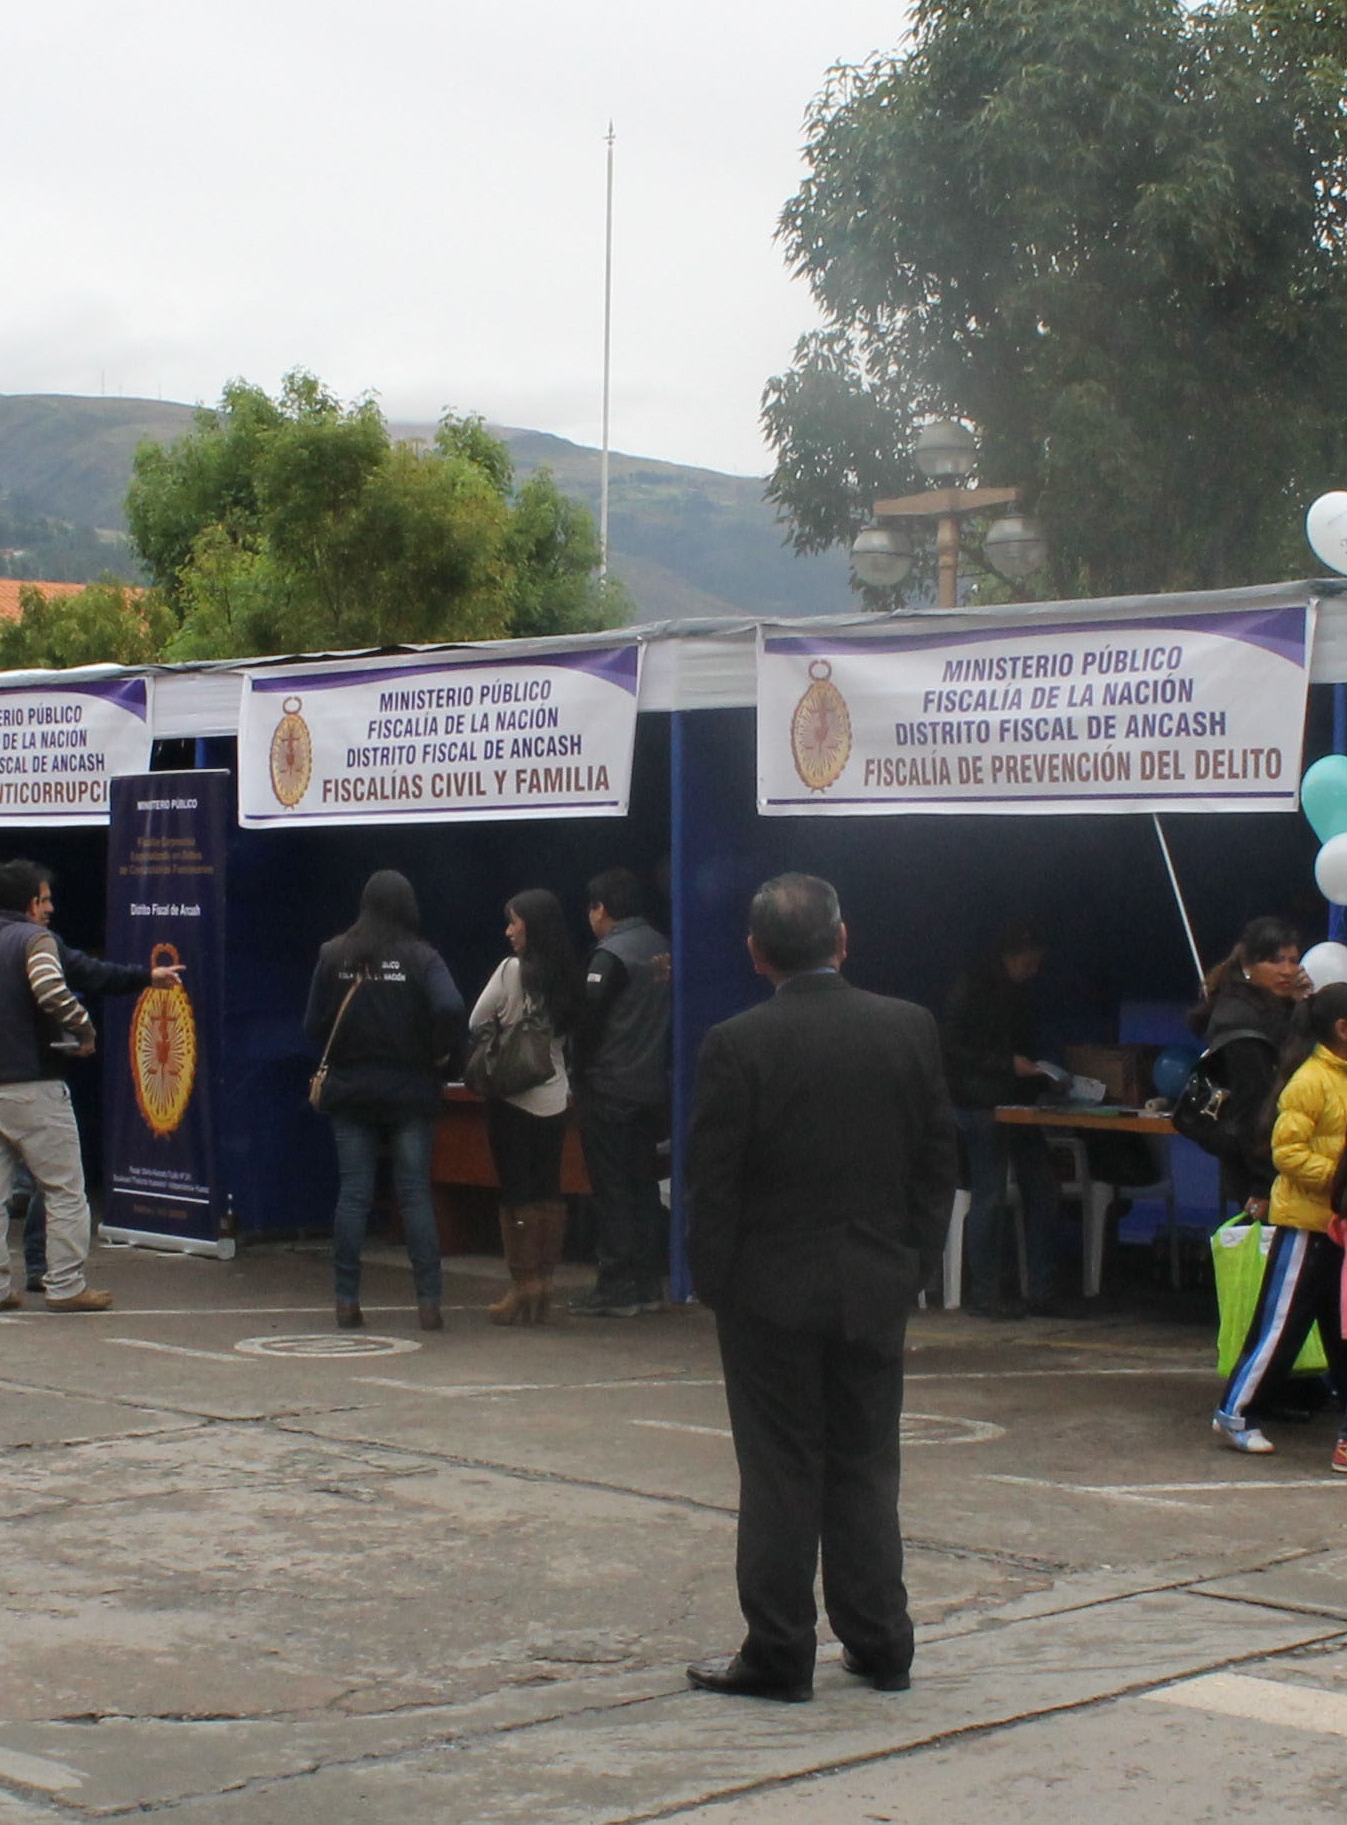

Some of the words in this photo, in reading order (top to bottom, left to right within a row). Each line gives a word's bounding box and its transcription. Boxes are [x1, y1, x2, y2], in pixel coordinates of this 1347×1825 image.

[941, 652, 1073, 683] MINISTERIO
[1082, 645, 1183, 675] PÚBLICO
[380, 687, 473, 712] MINISTERIO
[480, 679, 551, 705] PÚBLICO
[923, 683, 1021, 714] FISCALÍA
[1031, 686, 1060, 709] DE
[1067, 684, 1094, 707] LA
[1102, 673, 1194, 705] NACIÓN
[28, 703, 82, 725] PÚBLICO
[367, 713, 438, 740] FISCALÍA
[445, 715, 463, 734] DE
[471, 714, 489, 733] LA
[496, 703, 558, 731] NACIÓN
[895, 719, 990, 746] DISTRITO
[999, 717, 1079, 742] FISCAL
[1087, 715, 1116, 739] DE
[1125, 711, 1227, 738] ANCASH
[3, 733, 17, 749] DE
[22, 732, 36, 749] LA
[41, 725, 87, 748] NACIÓN
[347, 745, 416, 768] DISTRITO
[422, 741, 477, 764] FISCAL
[484, 740, 504, 760] DE
[510, 735, 582, 758] ANCASH
[33, 755, 47, 773] DE
[52, 753, 105, 772] ANCASH
[864, 750, 952, 786] FISCALÍA
[958, 755, 985, 785] DE
[992, 744, 1132, 784] PREVENCIÓN
[1140, 749, 1185, 781] DEL
[1194, 747, 1282, 780] DELITO
[322, 770, 423, 803] FISCALÍAS
[431, 772, 486, 798] CIVIL
[494, 770, 507, 795] Y
[516, 765, 610, 794] FAMILIA
